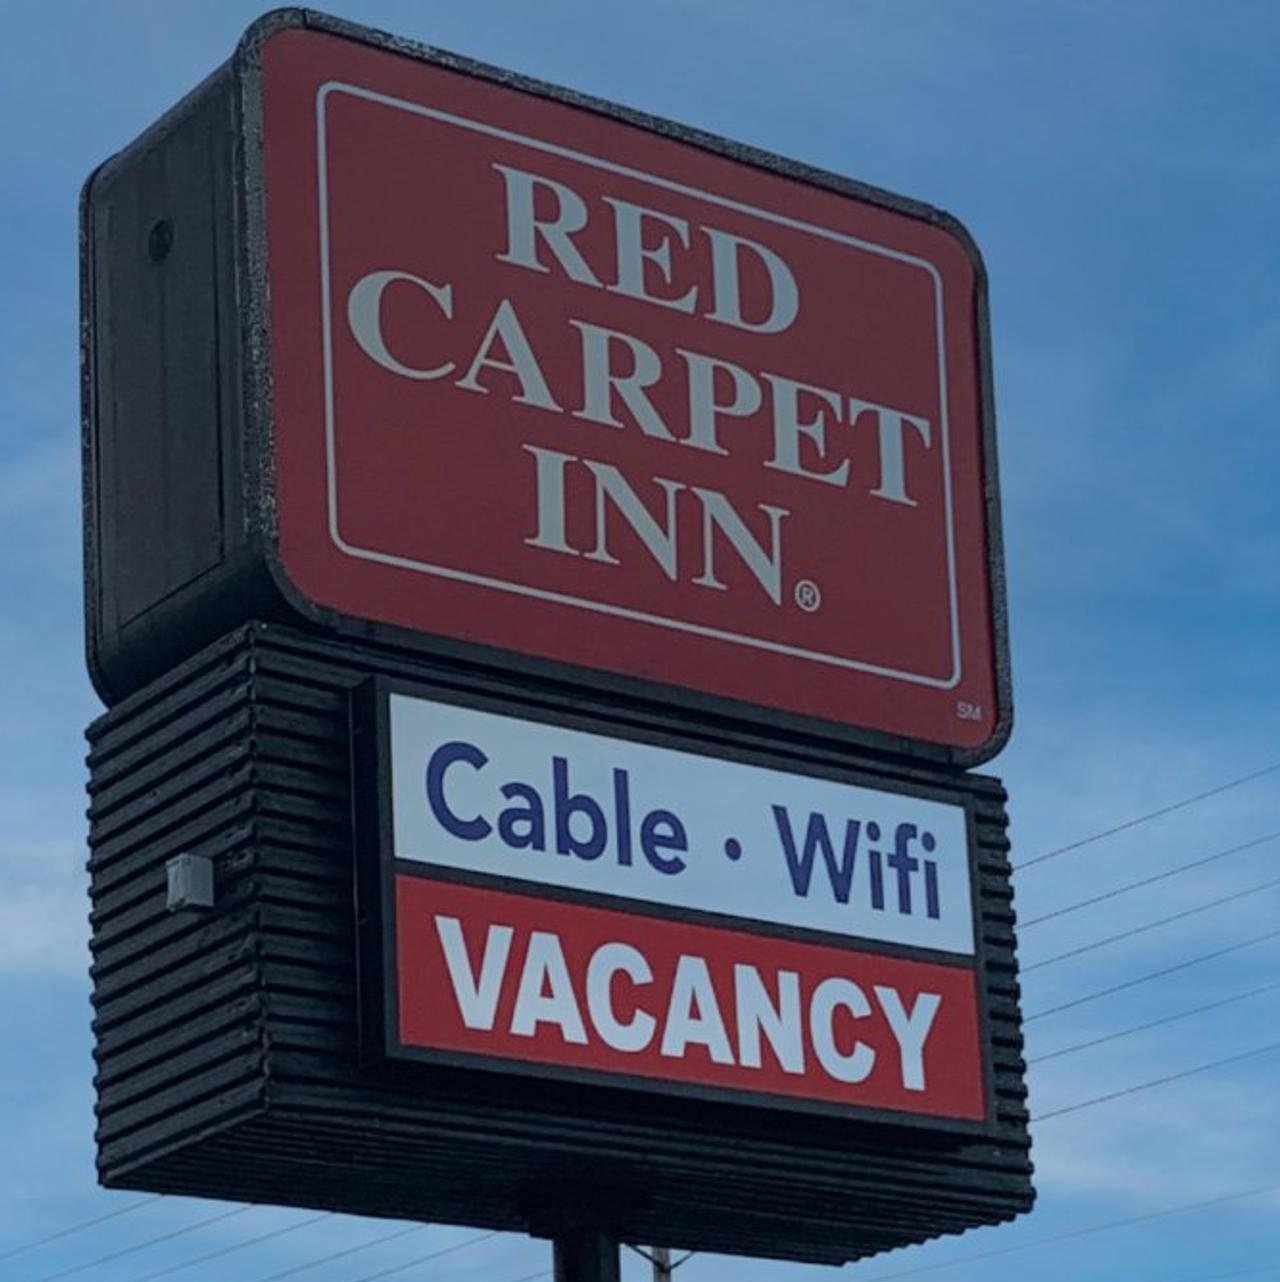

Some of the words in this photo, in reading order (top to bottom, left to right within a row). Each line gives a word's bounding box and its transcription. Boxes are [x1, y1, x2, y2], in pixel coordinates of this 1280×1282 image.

[491, 162, 800, 335] RED
[346, 268, 932, 508] CARPET
[956, 700, 982, 721] SM
[425, 739, 689, 876] Cable
[770, 803, 942, 920] Wifi
[433, 913, 942, 1092] VACANCY
